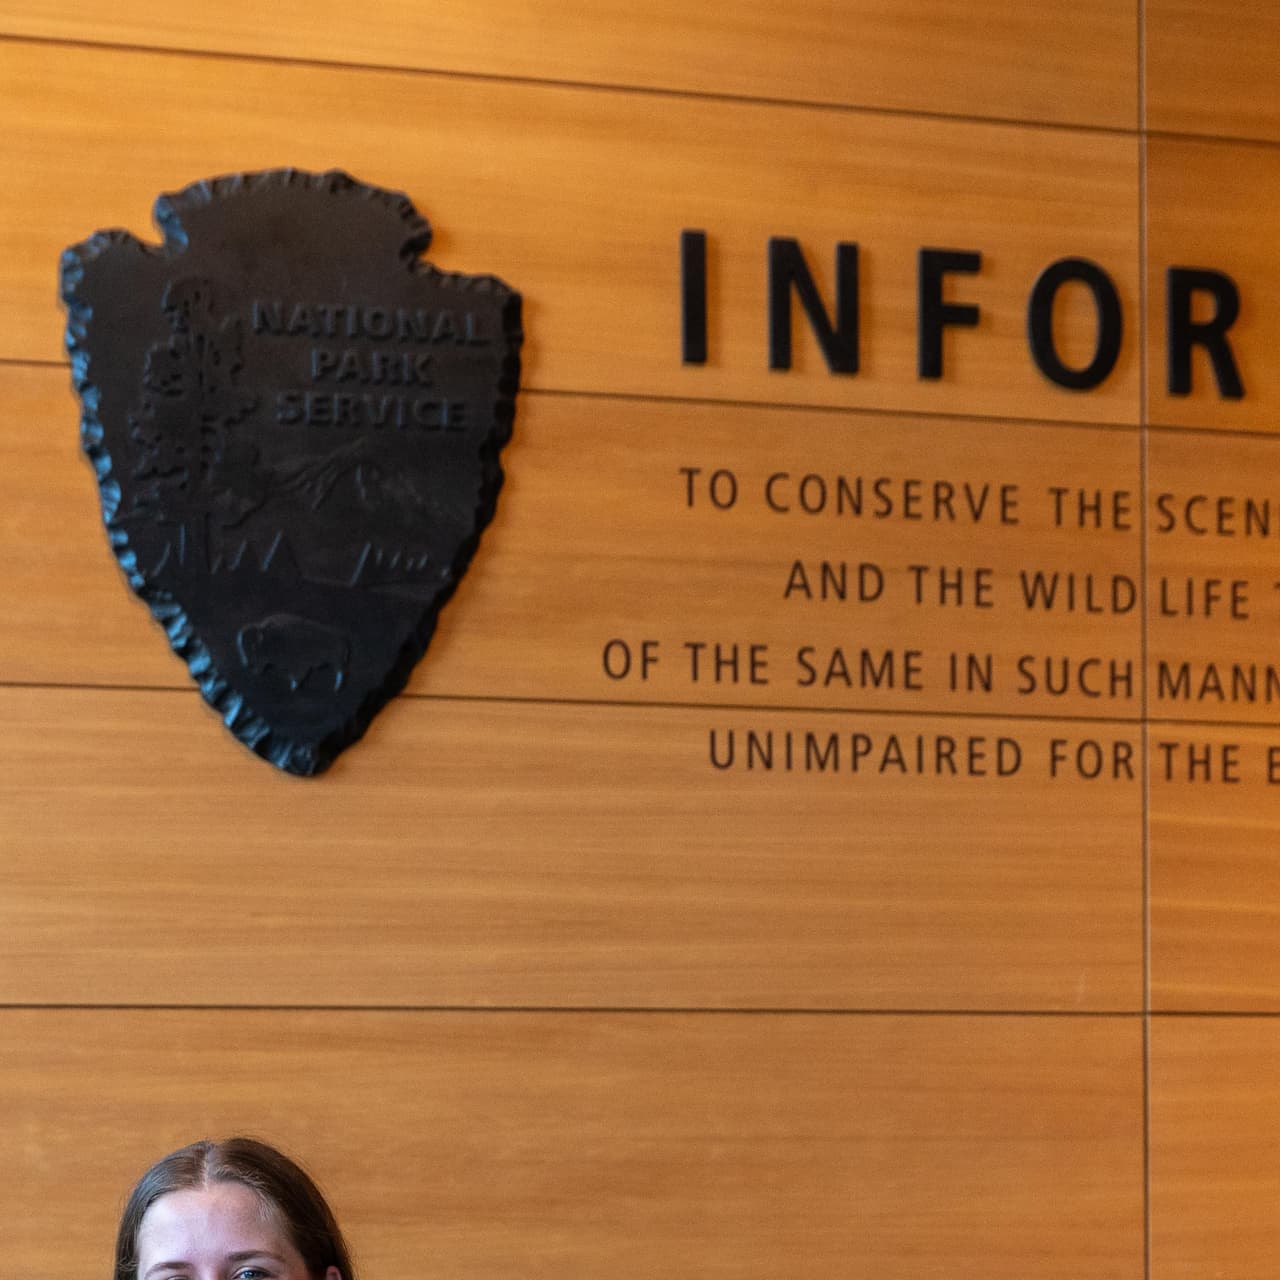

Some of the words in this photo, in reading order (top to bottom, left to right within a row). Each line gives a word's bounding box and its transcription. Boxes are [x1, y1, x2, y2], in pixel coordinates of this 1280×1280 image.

[250, 301, 490, 346] NATIONAL
[310, 348, 434, 388] PARK
[275, 391, 468, 431] SERVICE
[679, 468, 738, 511] TO
[764, 472, 1019, 525] CONSERVE
[1048, 487, 1131, 530] THE
[784, 559, 885, 603] AND
[908, 565, 994, 608] THE
[1020, 571, 1137, 615] WILD
[1160, 577, 1250, 620] LIFE
[602, 638, 660, 681] OF
[684, 642, 770, 685] THE
[796, 646, 924, 690] SAME
[949, 653, 994, 693] IN
[1017, 655, 1134, 699] SUCH
[709, 729, 1022, 778] UNIMPAIRED
[1049, 739, 1135, 780] FOR
[1158, 742, 1242, 785] THE
